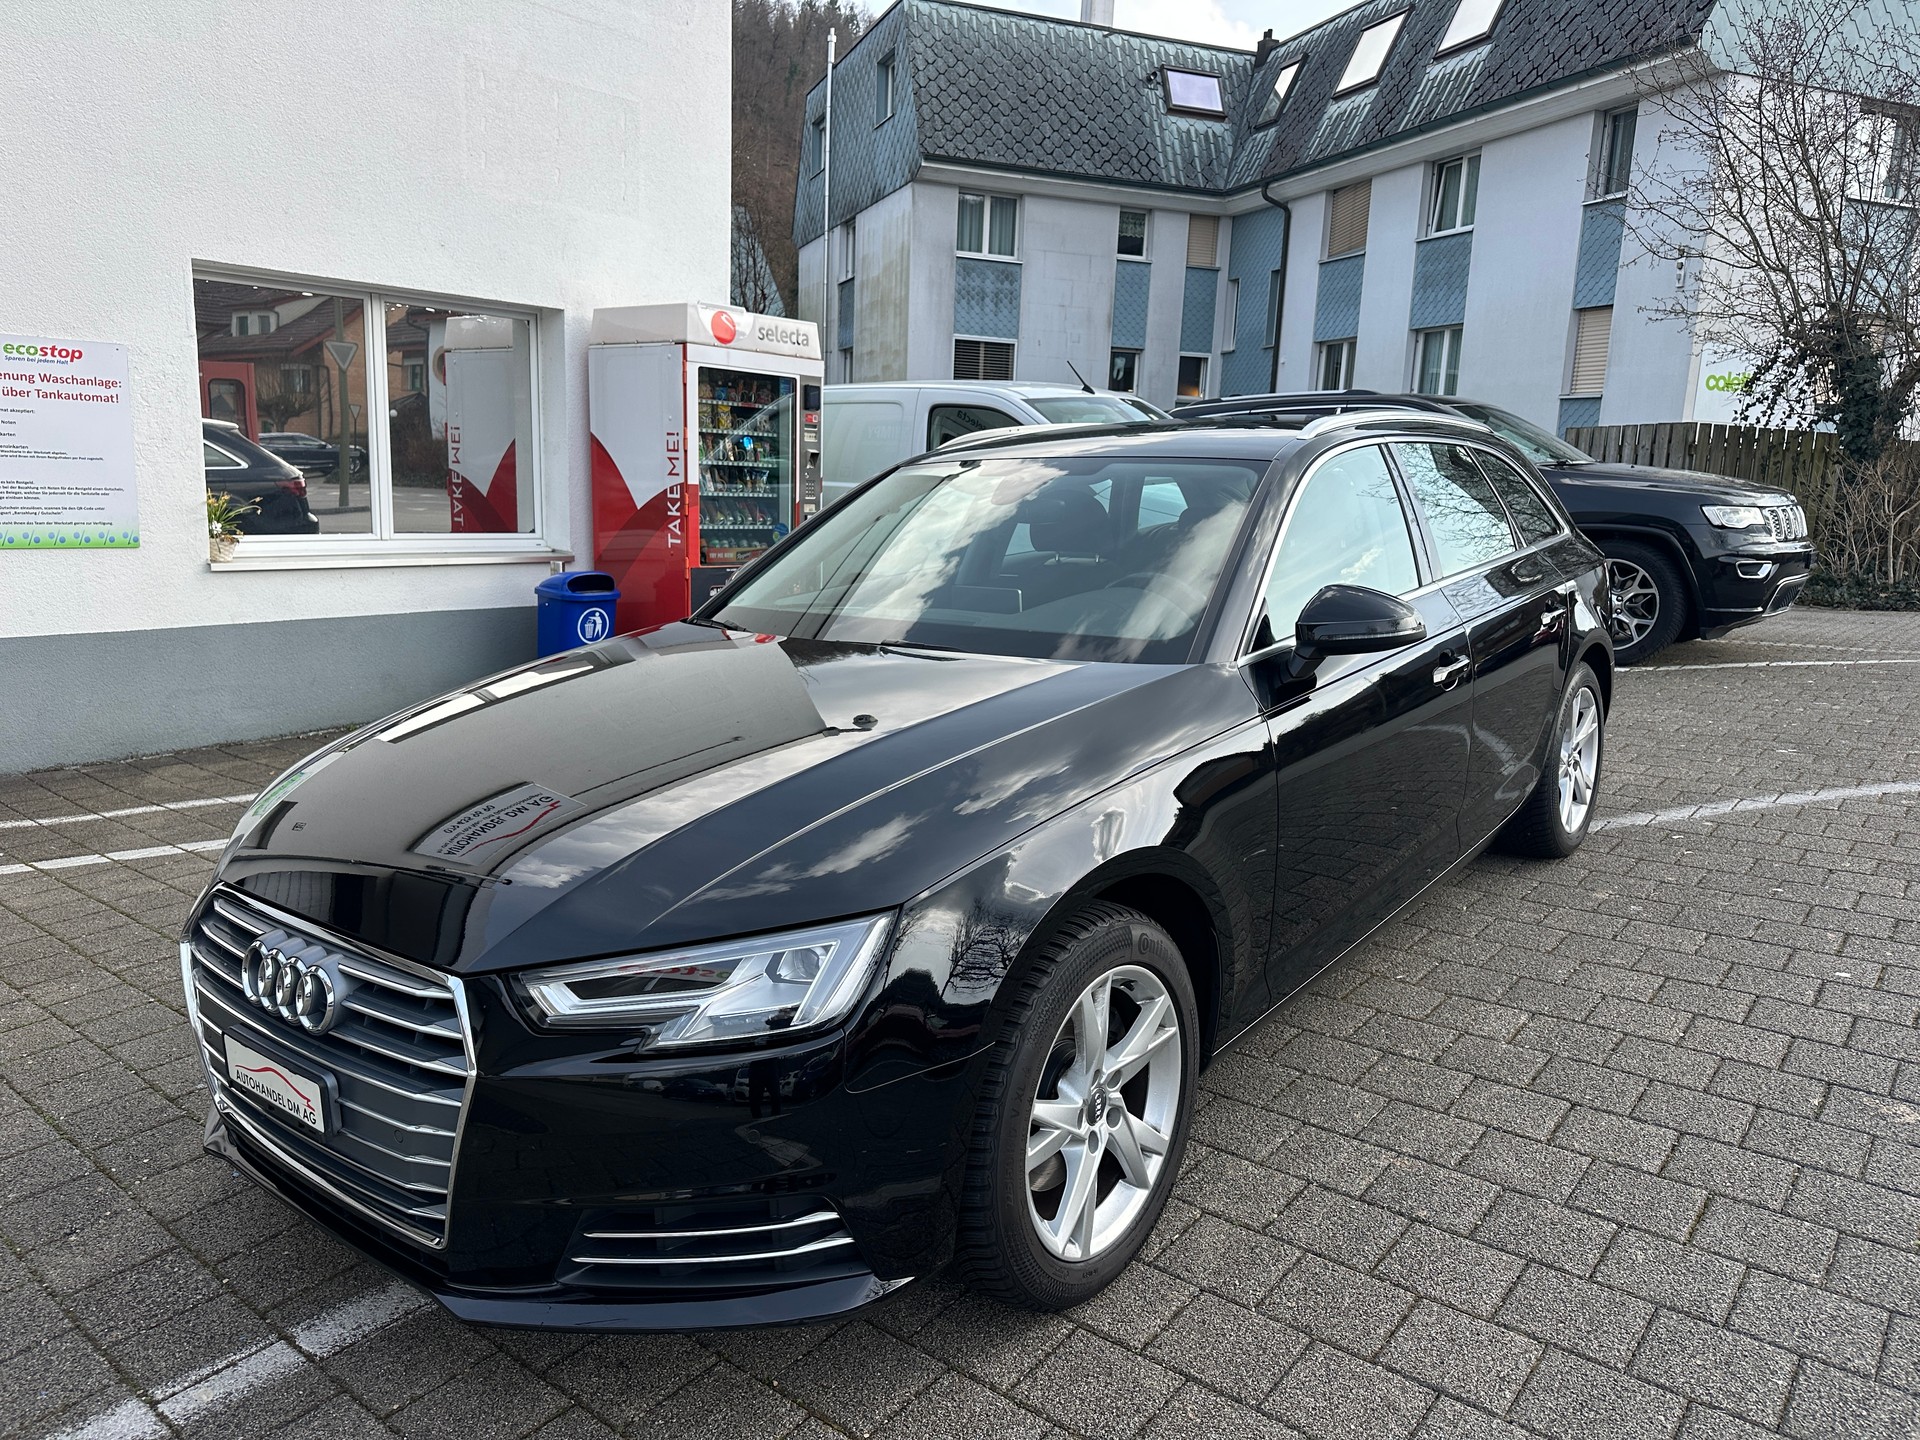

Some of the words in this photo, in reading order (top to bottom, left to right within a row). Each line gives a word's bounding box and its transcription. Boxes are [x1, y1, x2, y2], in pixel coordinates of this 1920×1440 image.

[758, 325, 809, 347] selecta
[3, 343, 83, 362] ecostop
[38, 372, 122, 389] Waschanlage:
[2, 386, 31, 398] über
[34, 388, 119, 403] Tankautomat!
[666, 432, 680, 476] ME!
[667, 485, 681, 548] TAKE
[236, 1070, 286, 1108] AUTOHANDEL
[287, 1098, 300, 1116] DM
[303, 1108, 316, 1124] AG
